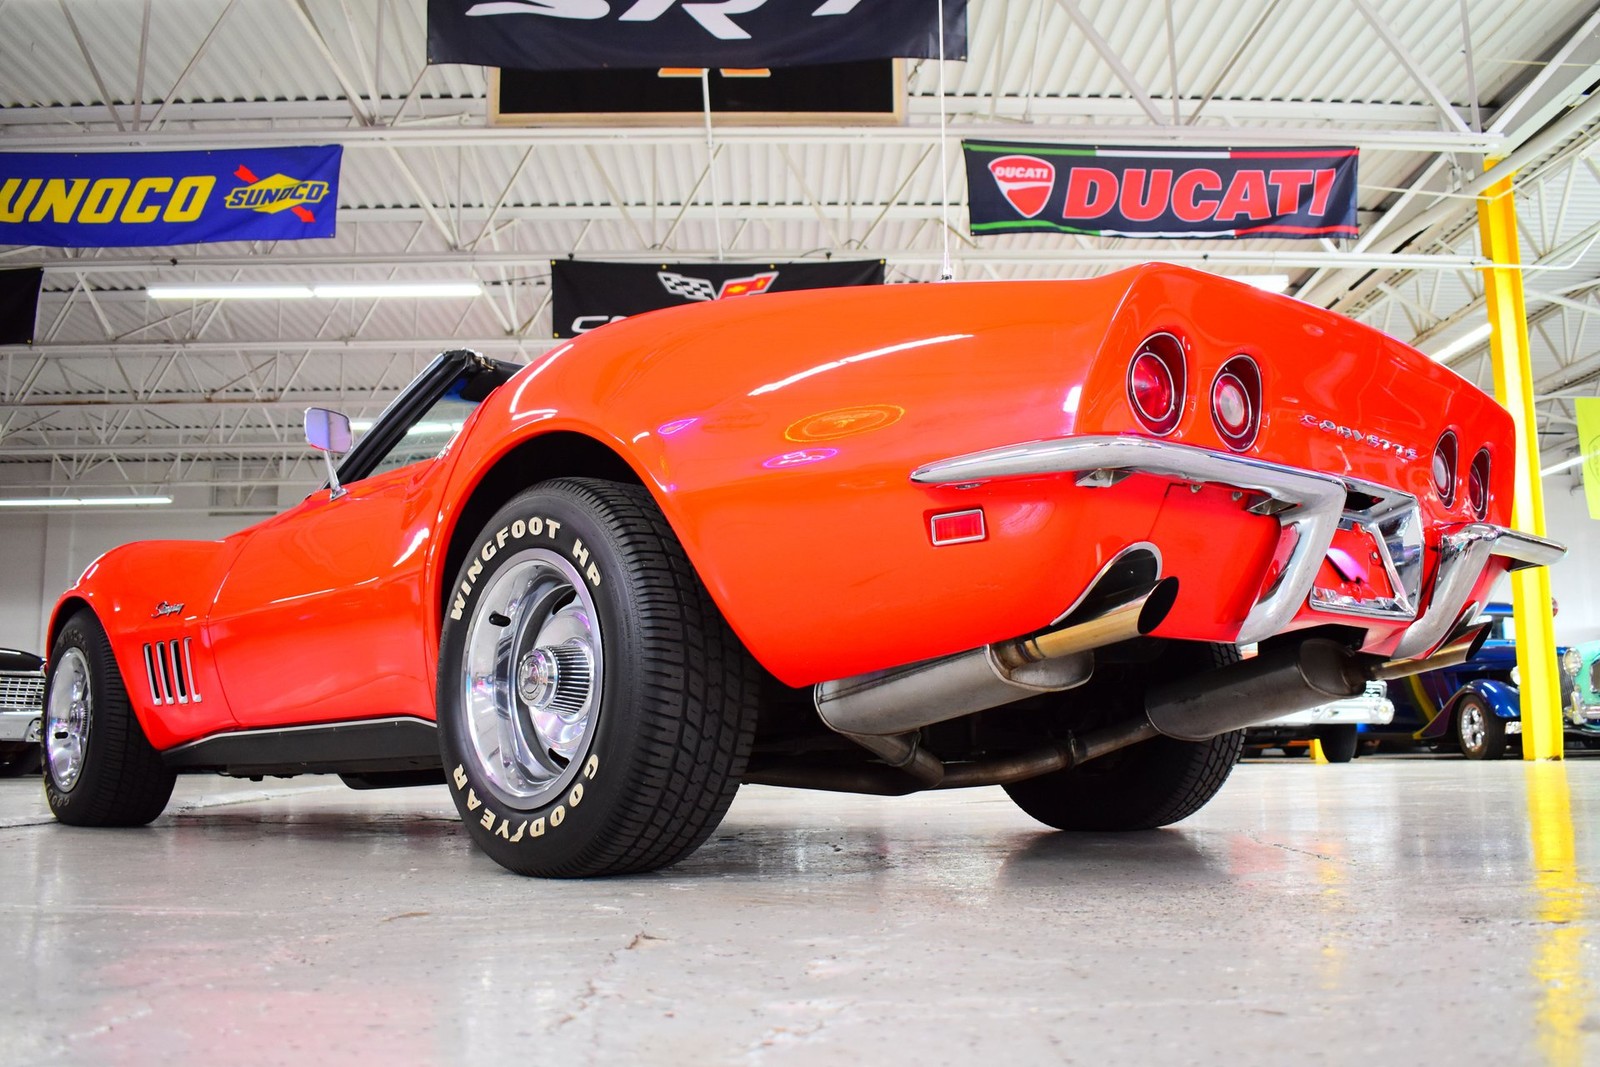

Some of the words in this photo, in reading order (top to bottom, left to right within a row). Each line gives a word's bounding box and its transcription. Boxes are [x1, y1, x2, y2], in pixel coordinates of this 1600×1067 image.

[228, 183, 325, 207] SUNOCO
[995, 166, 1049, 179] DUCATI
[1062, 167, 1336, 222] DUCATI
[1300, 414, 1419, 460] CORVETTE
[450, 516, 561, 621] WINGFOOT
[572, 538, 601, 587] HP
[453, 754, 599, 842] GOODYEAR
